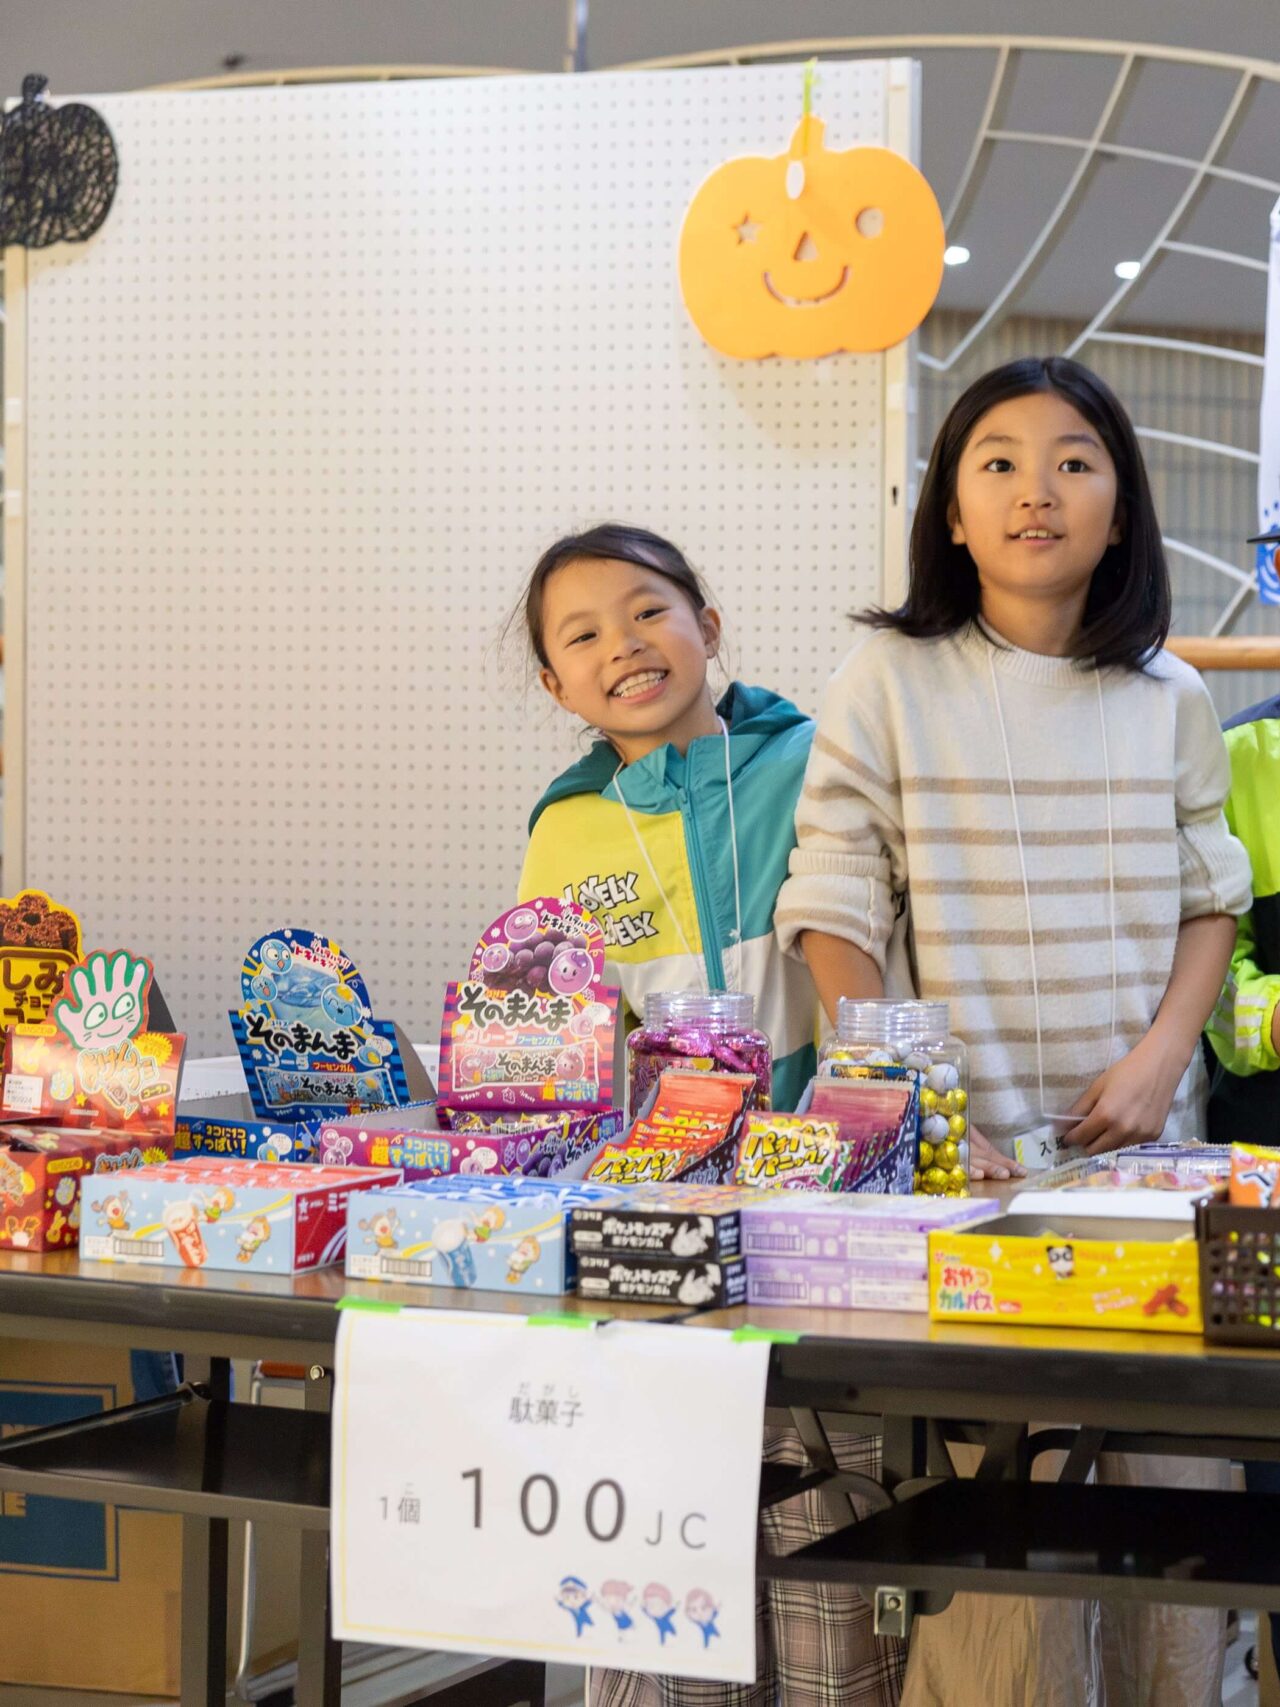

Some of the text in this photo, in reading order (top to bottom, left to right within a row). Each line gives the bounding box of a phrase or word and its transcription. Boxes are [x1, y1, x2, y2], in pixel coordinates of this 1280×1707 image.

[460, 984, 571, 1032] そのまんま
[246, 1013, 357, 1060] そのまんま
[499, 1051, 556, 1076] そのまんま
[300, 1076, 358, 1098] そのまんま
[944, 1266, 989, 1288] おやつ
[518, 1383, 580, 1398] だがし
[509, 1397, 584, 1428] 駄菓子
[378, 1468, 708, 1549] 1個 100 JC
